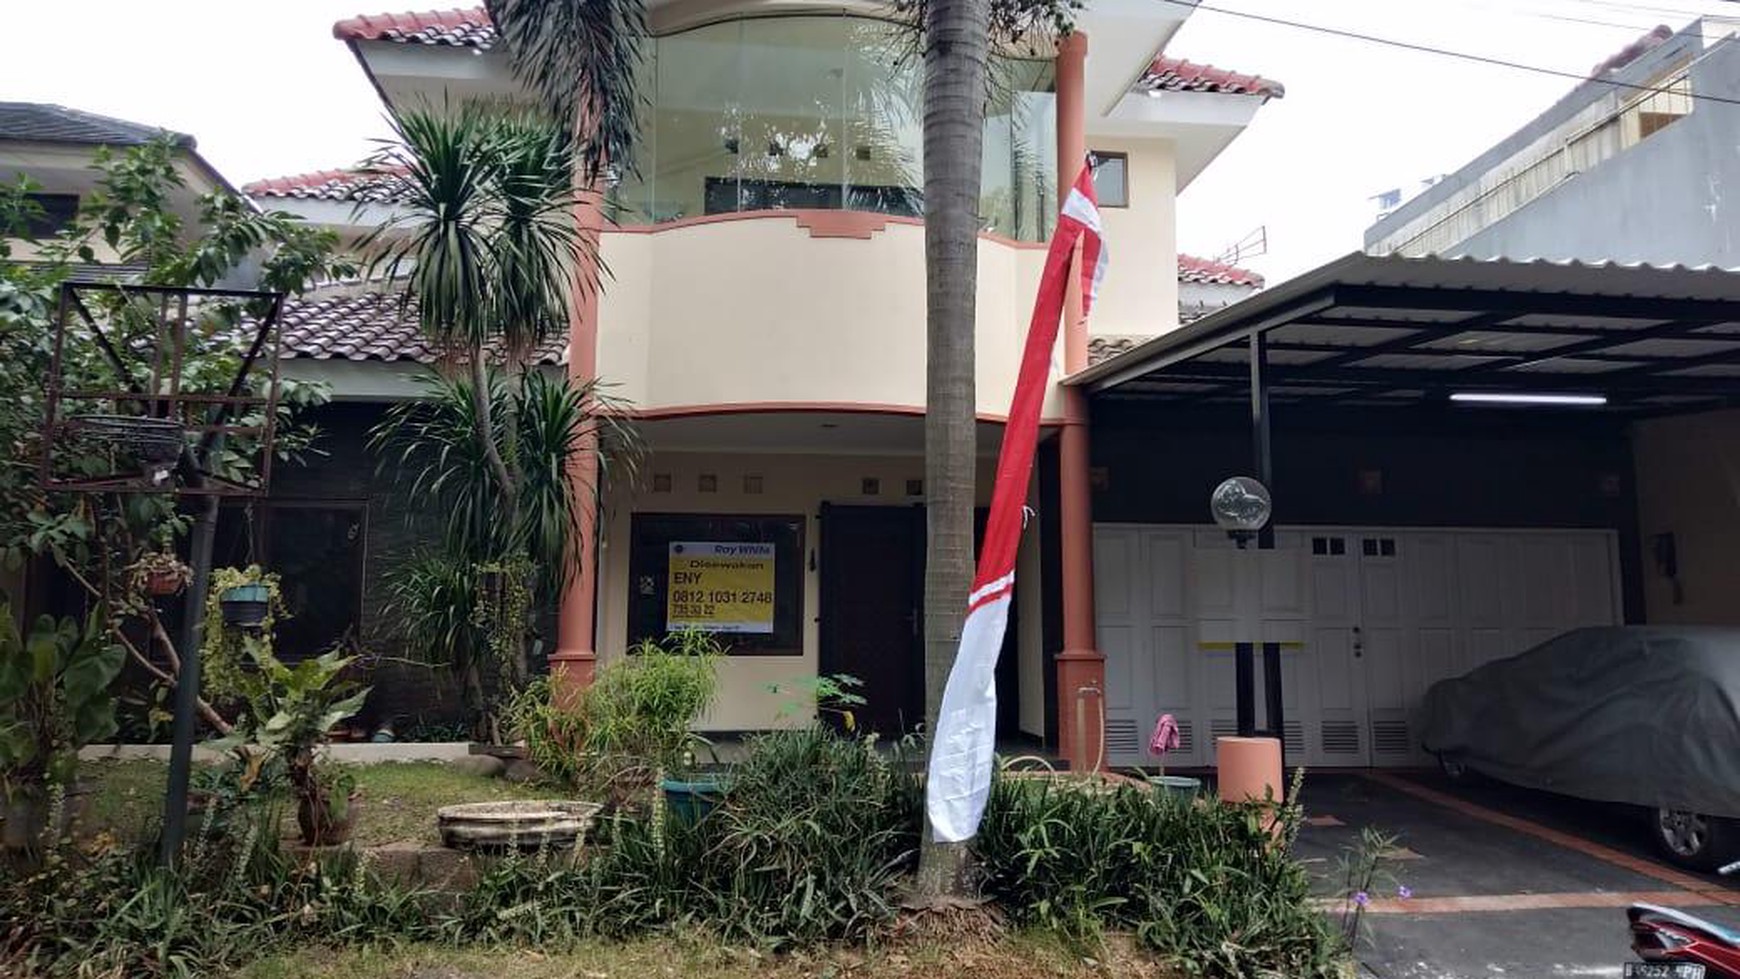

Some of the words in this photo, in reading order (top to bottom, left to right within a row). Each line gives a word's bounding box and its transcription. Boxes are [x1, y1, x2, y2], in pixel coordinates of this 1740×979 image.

[673, 571, 702, 584] ENY
[673, 590, 704, 603] 0812
[708, 591, 737, 603] 1031
[741, 591, 772, 604] 2748
